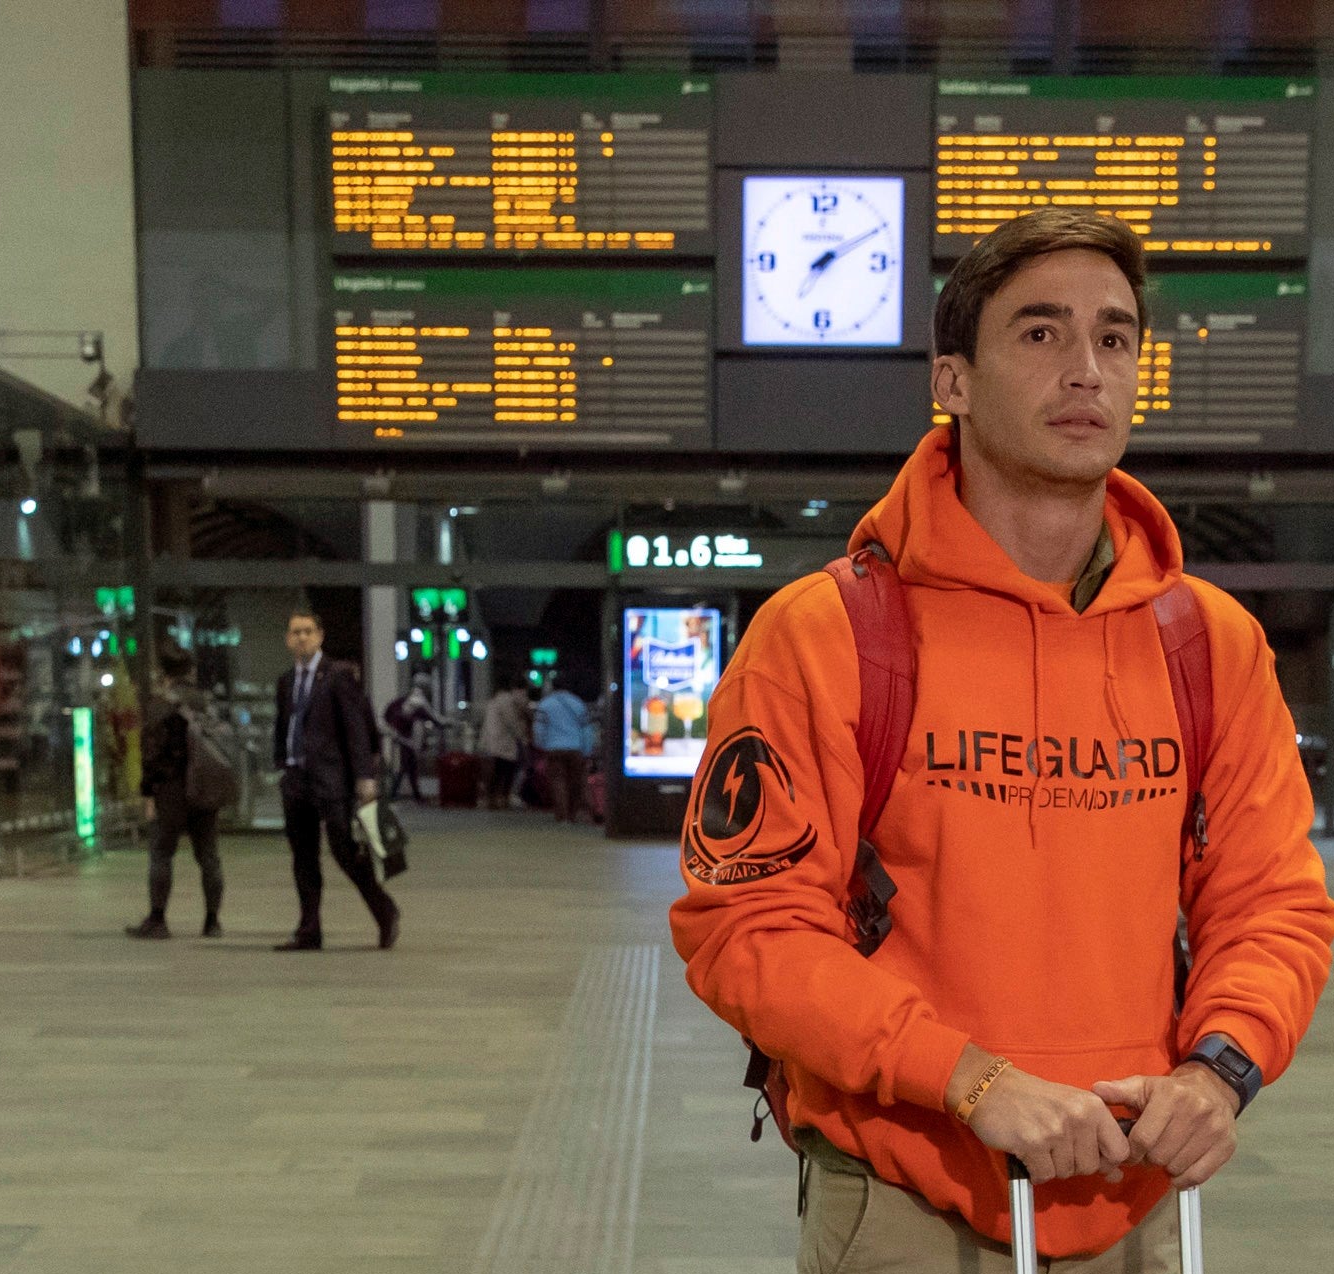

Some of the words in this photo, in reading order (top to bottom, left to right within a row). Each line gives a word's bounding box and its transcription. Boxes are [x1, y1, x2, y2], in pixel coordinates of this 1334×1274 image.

[811, 193, 839, 215] 12
[758, 252, 777, 272] 9
[869, 253, 887, 273] 3
[813, 310, 831, 328] 6
[926, 730, 1180, 780] LIFEGUARD
[967, 1056, 1008, 1105] ROEM-AID
